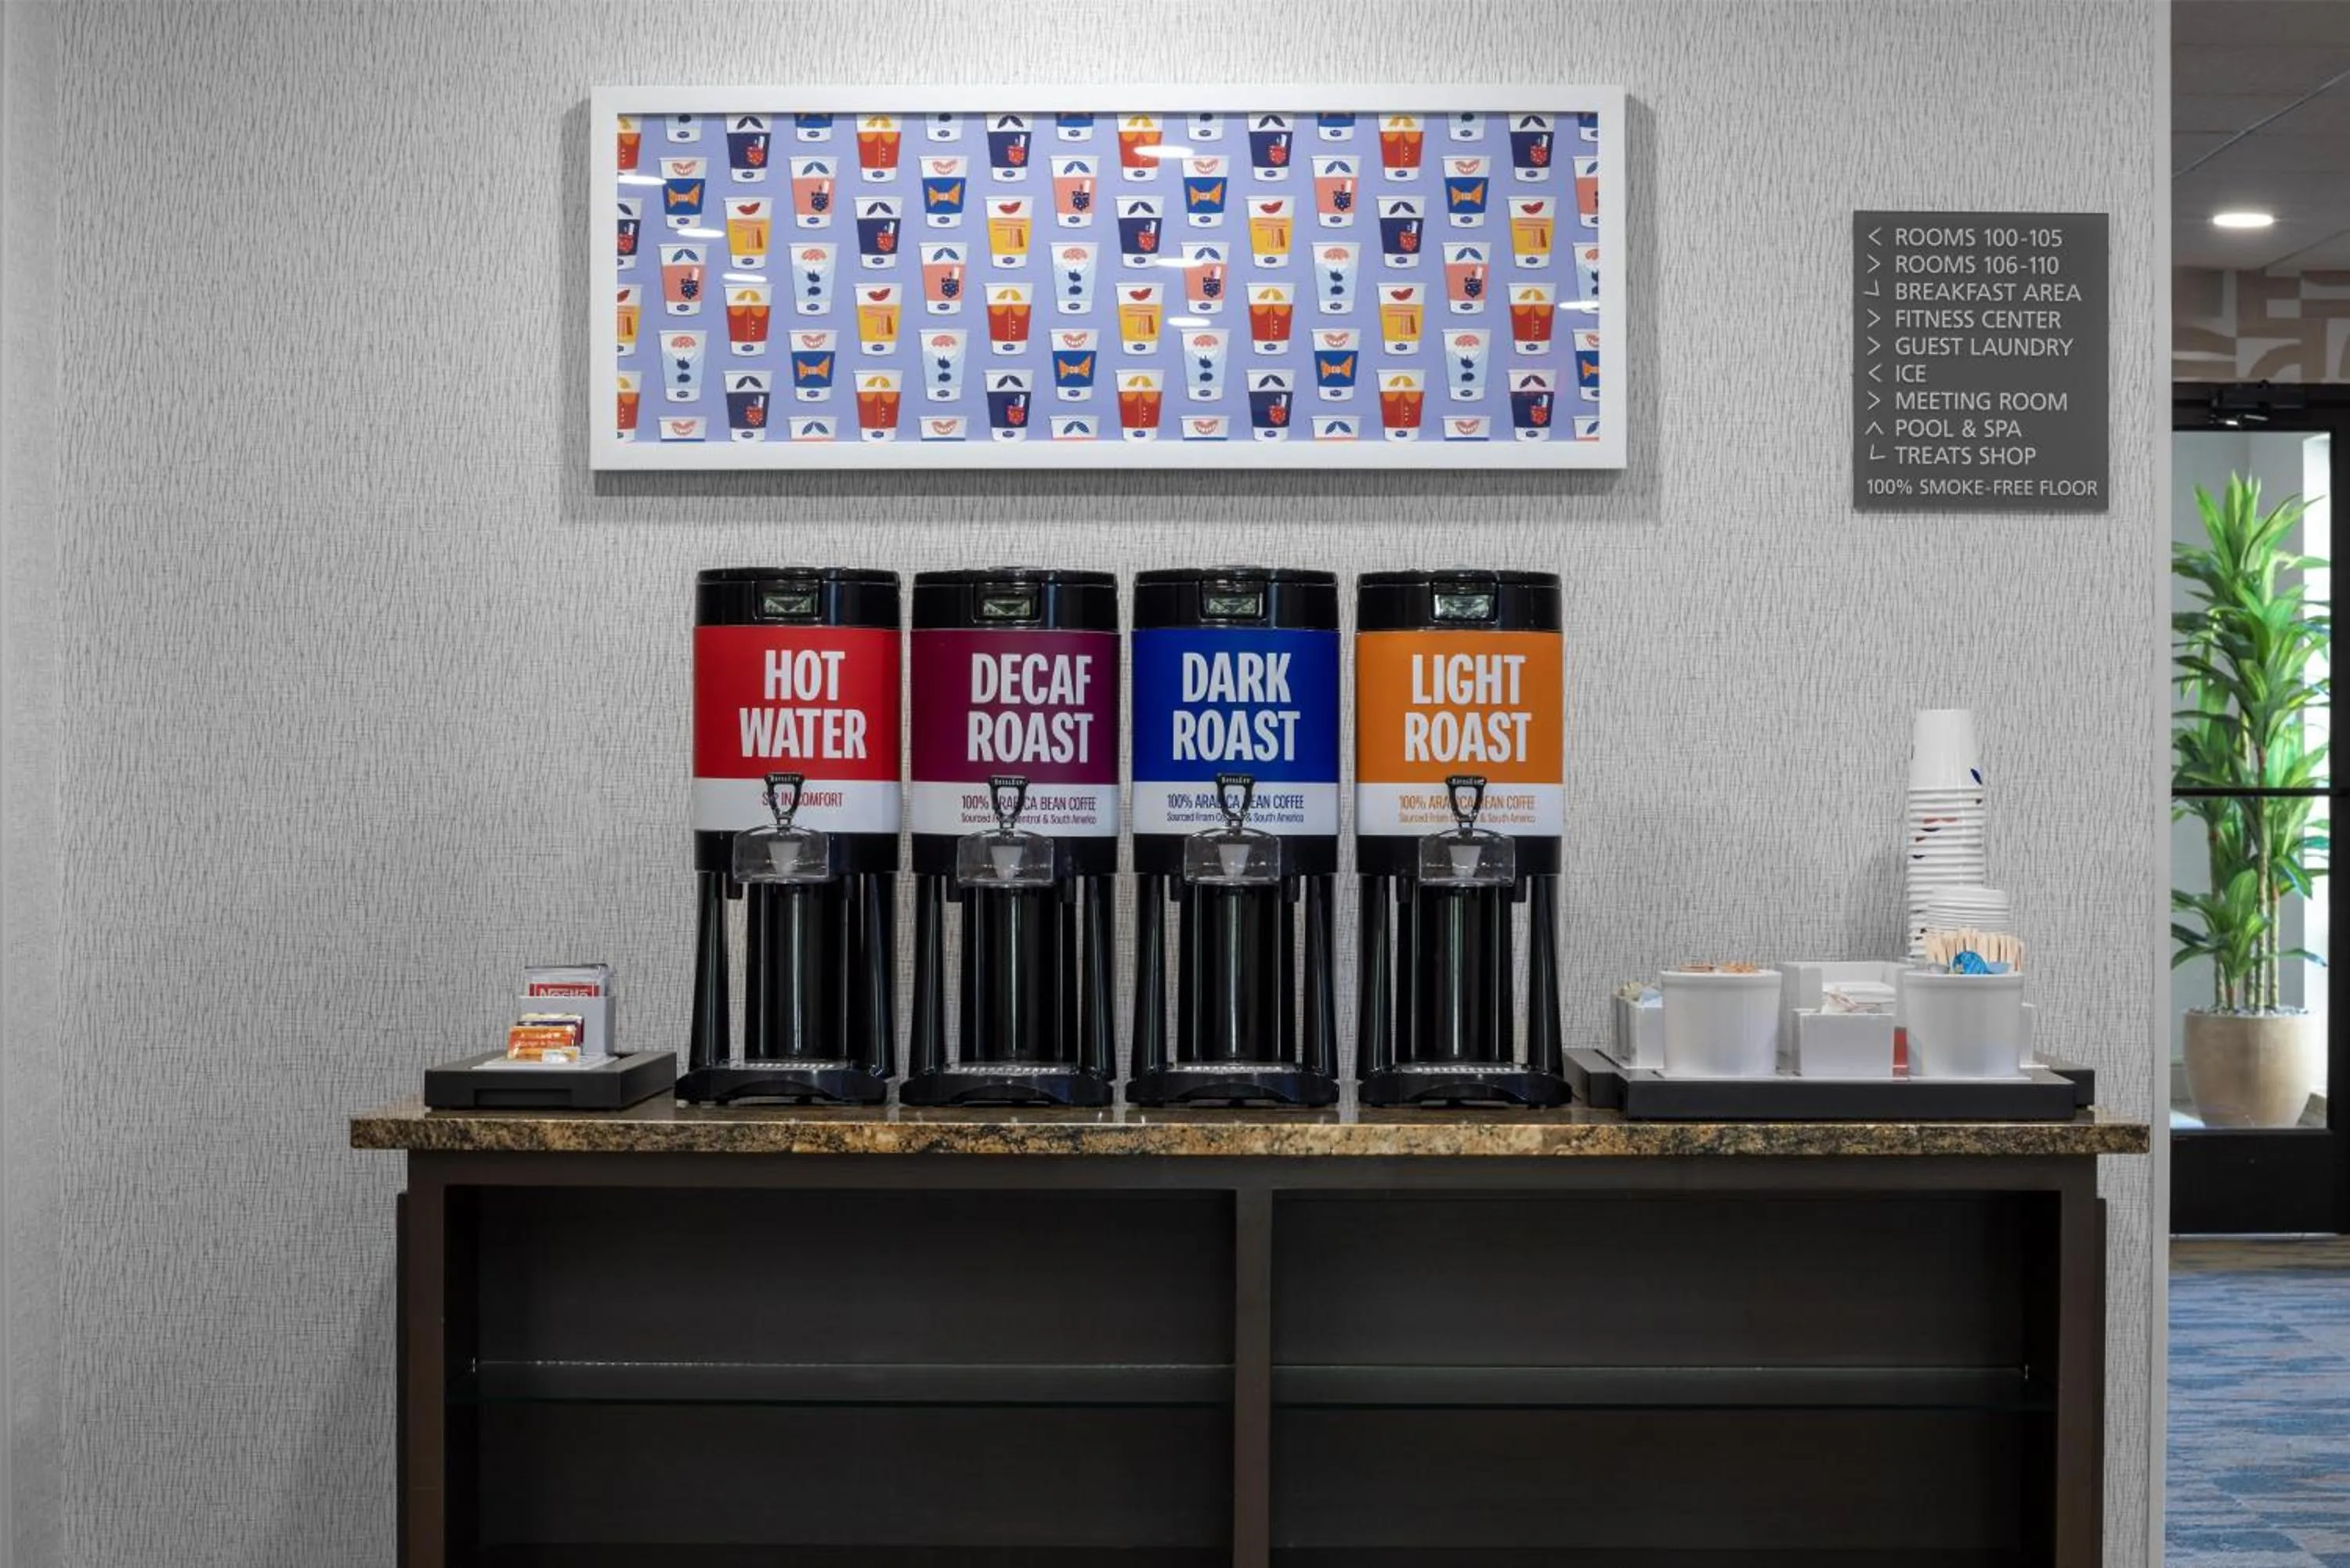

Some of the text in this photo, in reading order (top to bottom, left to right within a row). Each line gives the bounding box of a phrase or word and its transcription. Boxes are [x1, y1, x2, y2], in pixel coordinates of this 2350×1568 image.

[1896, 228, 2063, 247] ROOMS 100-105
[1896, 255, 2059, 274] ROOMS 106-110
[1896, 283, 2082, 302] BREAKFAST AREA
[1896, 310, 2062, 328] FITNESS CENTER
[1896, 337, 2073, 356] GUEST LAUNDRY
[1896, 364, 1926, 382] ICE
[1896, 392, 2067, 410] MEETING ROOM
[1896, 419, 2023, 437] POOL & SPA
[1894, 446, 2037, 464] TREATS SHOP
[1867, 479, 2098, 496] 100% SMOKE-FREE FLOOR
[765, 649, 845, 701] HOT
[972, 653, 1092, 705] DECAF
[1182, 652, 1292, 703] DARK
[1412, 653, 1526, 705] LIGHT
[739, 707, 866, 759] WATER
[967, 710, 1094, 763] ROAST
[1173, 710, 1300, 761] ROAST
[1405, 711, 1532, 762] ROAST
[781, 793, 792, 806] IN
[797, 793, 843, 807] OMFORT
[962, 796, 989, 810] 100%
[1041, 797, 1066, 811] BEAN
[1068, 797, 1096, 811] COFFEE
[1167, 793, 1192, 808] 100%
[1249, 795, 1270, 809] EAN
[1273, 794, 1304, 809] COFFEE
[1481, 795, 1503, 809] EAN
